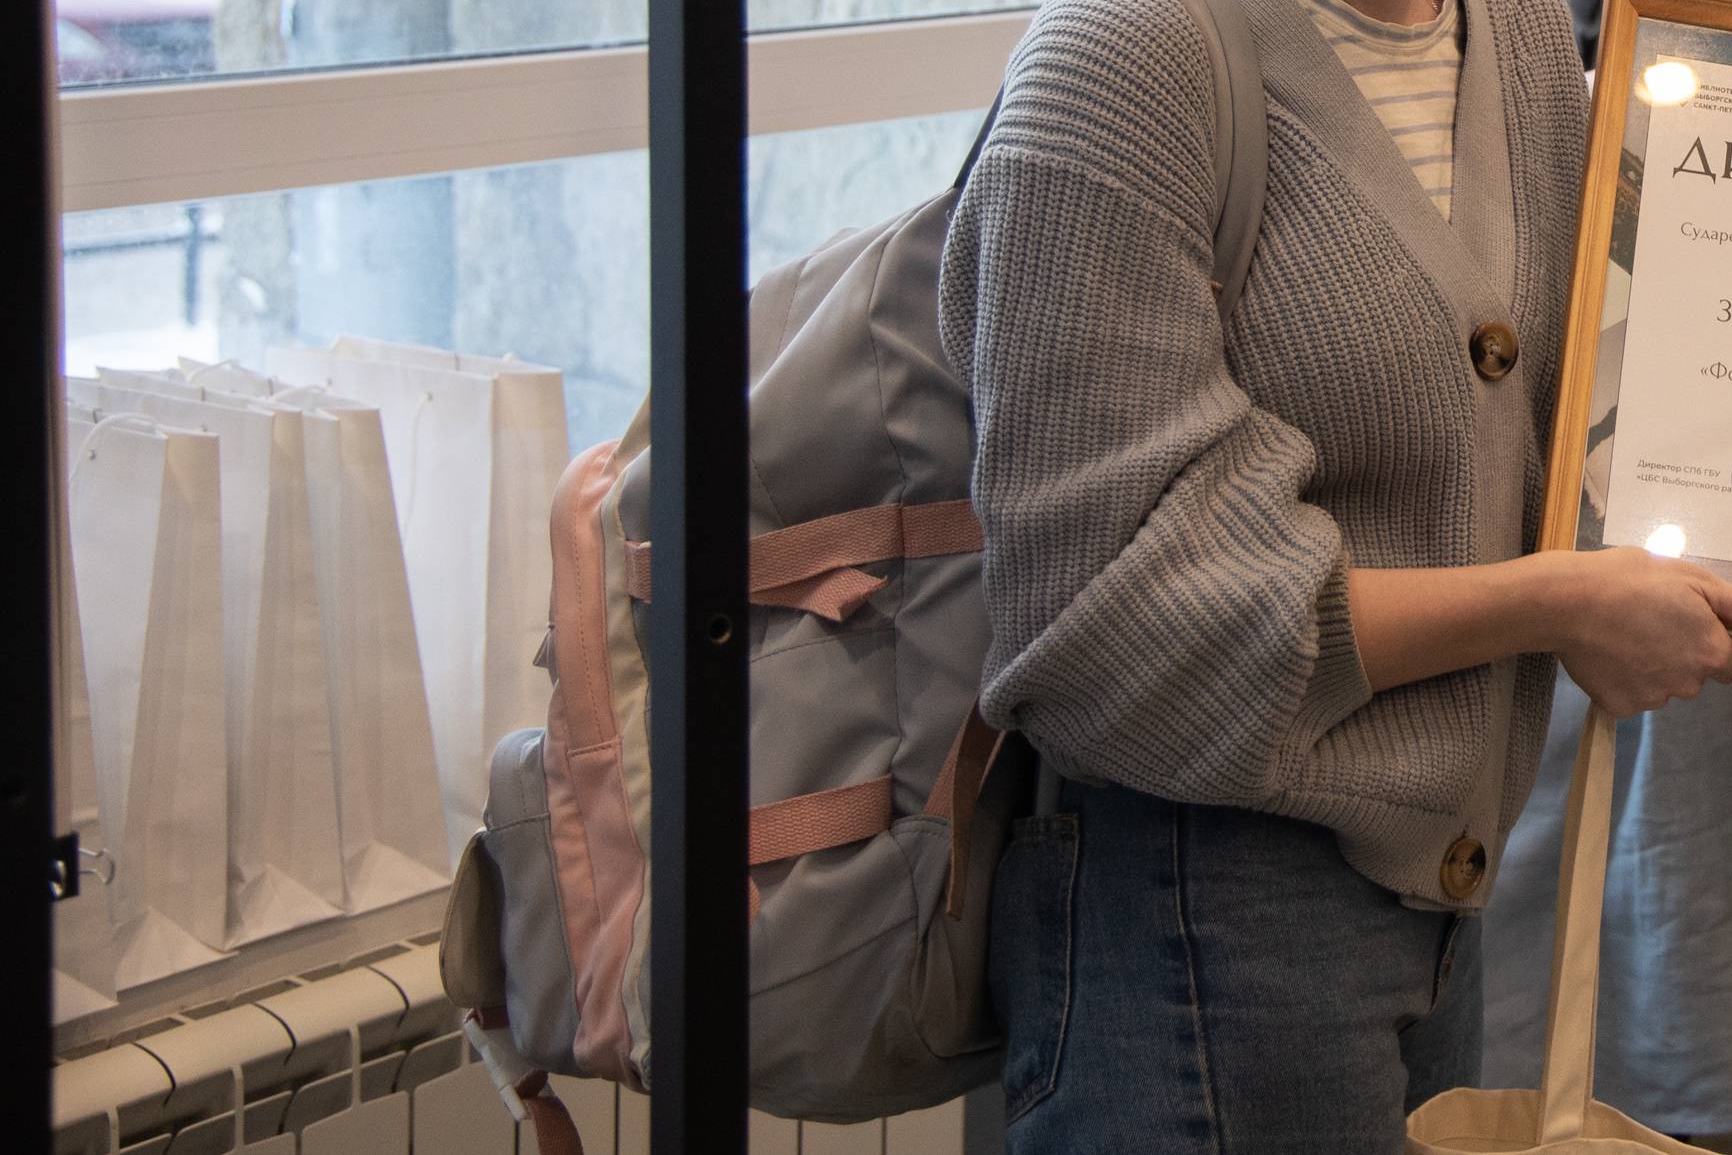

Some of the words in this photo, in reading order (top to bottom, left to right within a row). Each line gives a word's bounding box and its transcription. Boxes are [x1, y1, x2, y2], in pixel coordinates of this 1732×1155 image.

[1637, 459, 1682, 474] Директор
[1683, 465, 1702, 476] СПб
[1704, 468, 1721, 478] ГБУ
[1636, 474, 1661, 484] «ЦБС
[1662, 476, 1720, 492] Выборгского
